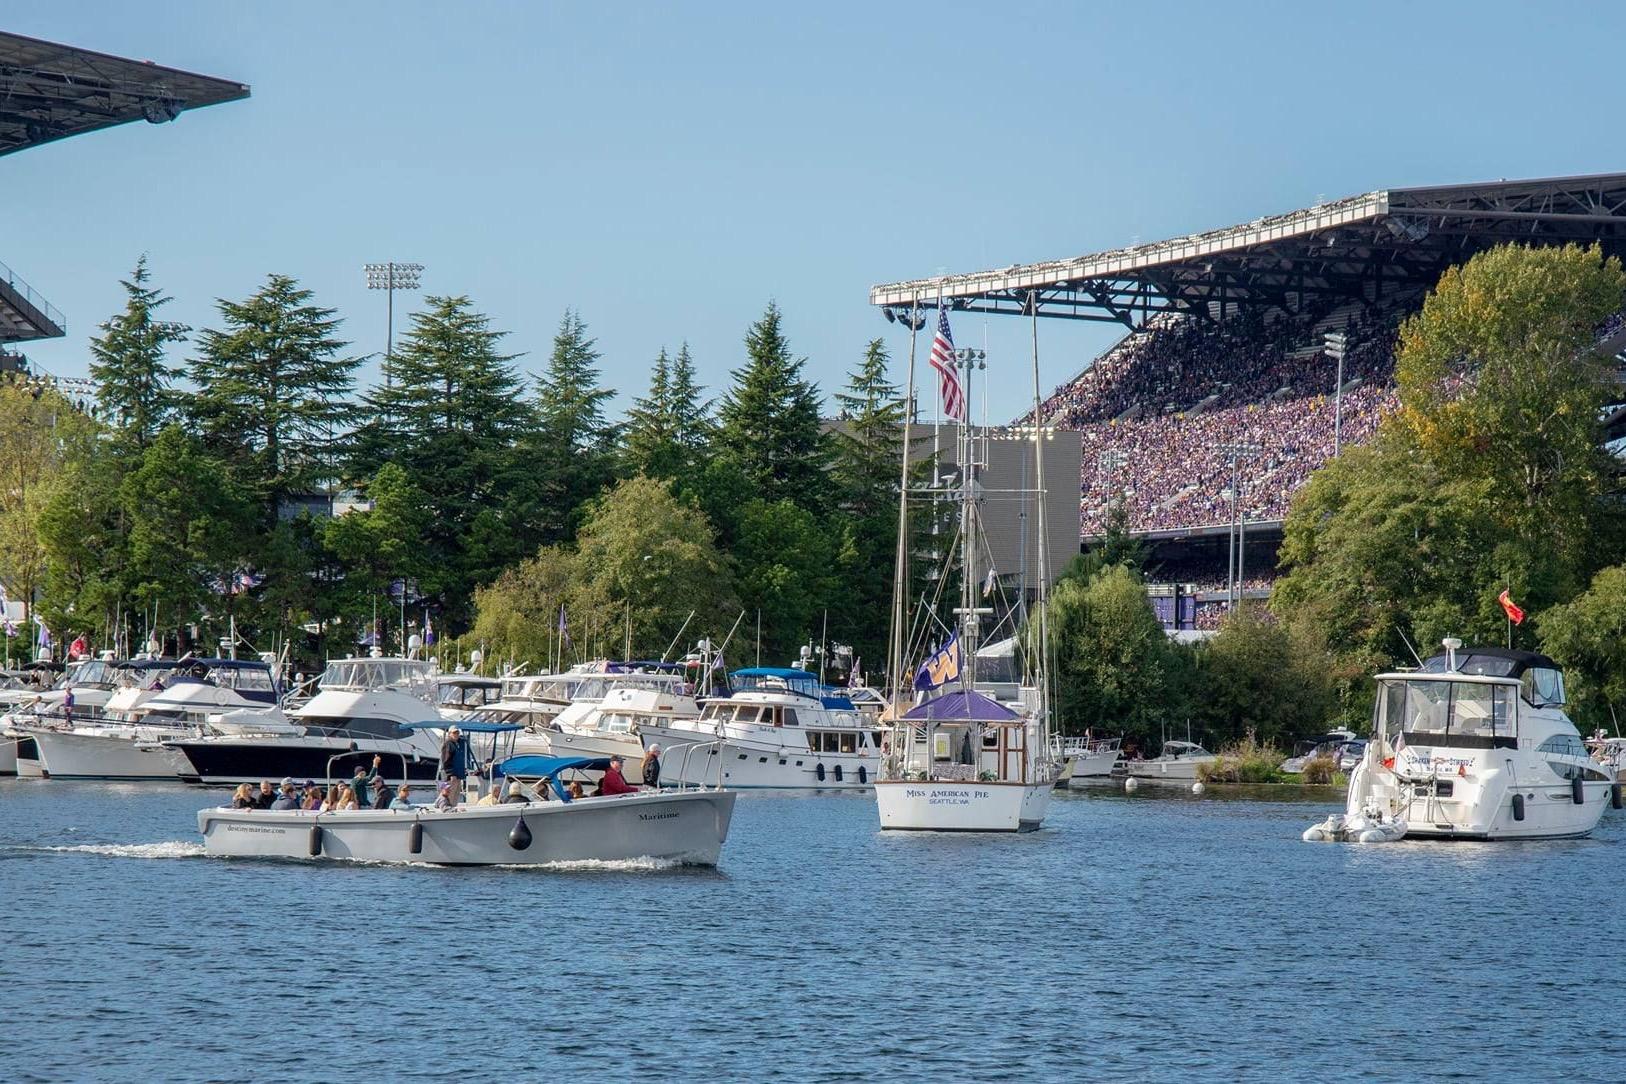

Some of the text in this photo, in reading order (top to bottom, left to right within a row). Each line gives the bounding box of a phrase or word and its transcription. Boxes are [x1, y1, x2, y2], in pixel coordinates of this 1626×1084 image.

[974, 790, 989, 798] PIE
[638, 812, 679, 821] Maritime
[227, 824, 286, 834] destinymarine.com
